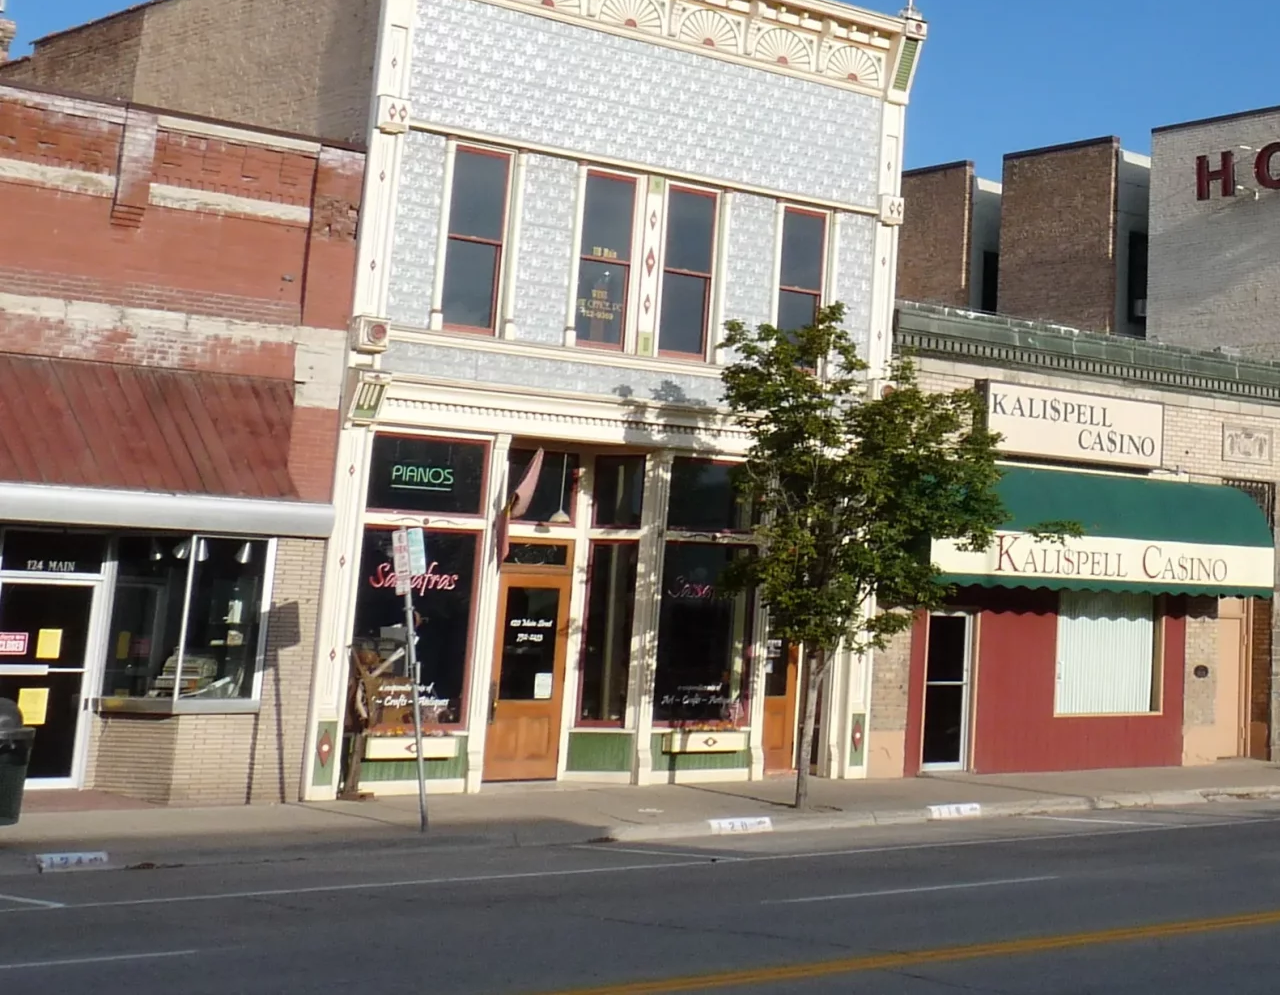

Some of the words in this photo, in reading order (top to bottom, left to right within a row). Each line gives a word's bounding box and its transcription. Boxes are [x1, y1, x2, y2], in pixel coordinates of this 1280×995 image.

[392, 465, 454, 485] PIANOS
[26, 559, 44, 570] 124
[48, 560, 76, 572] MAIN
[369, 561, 459, 597] Saafras
